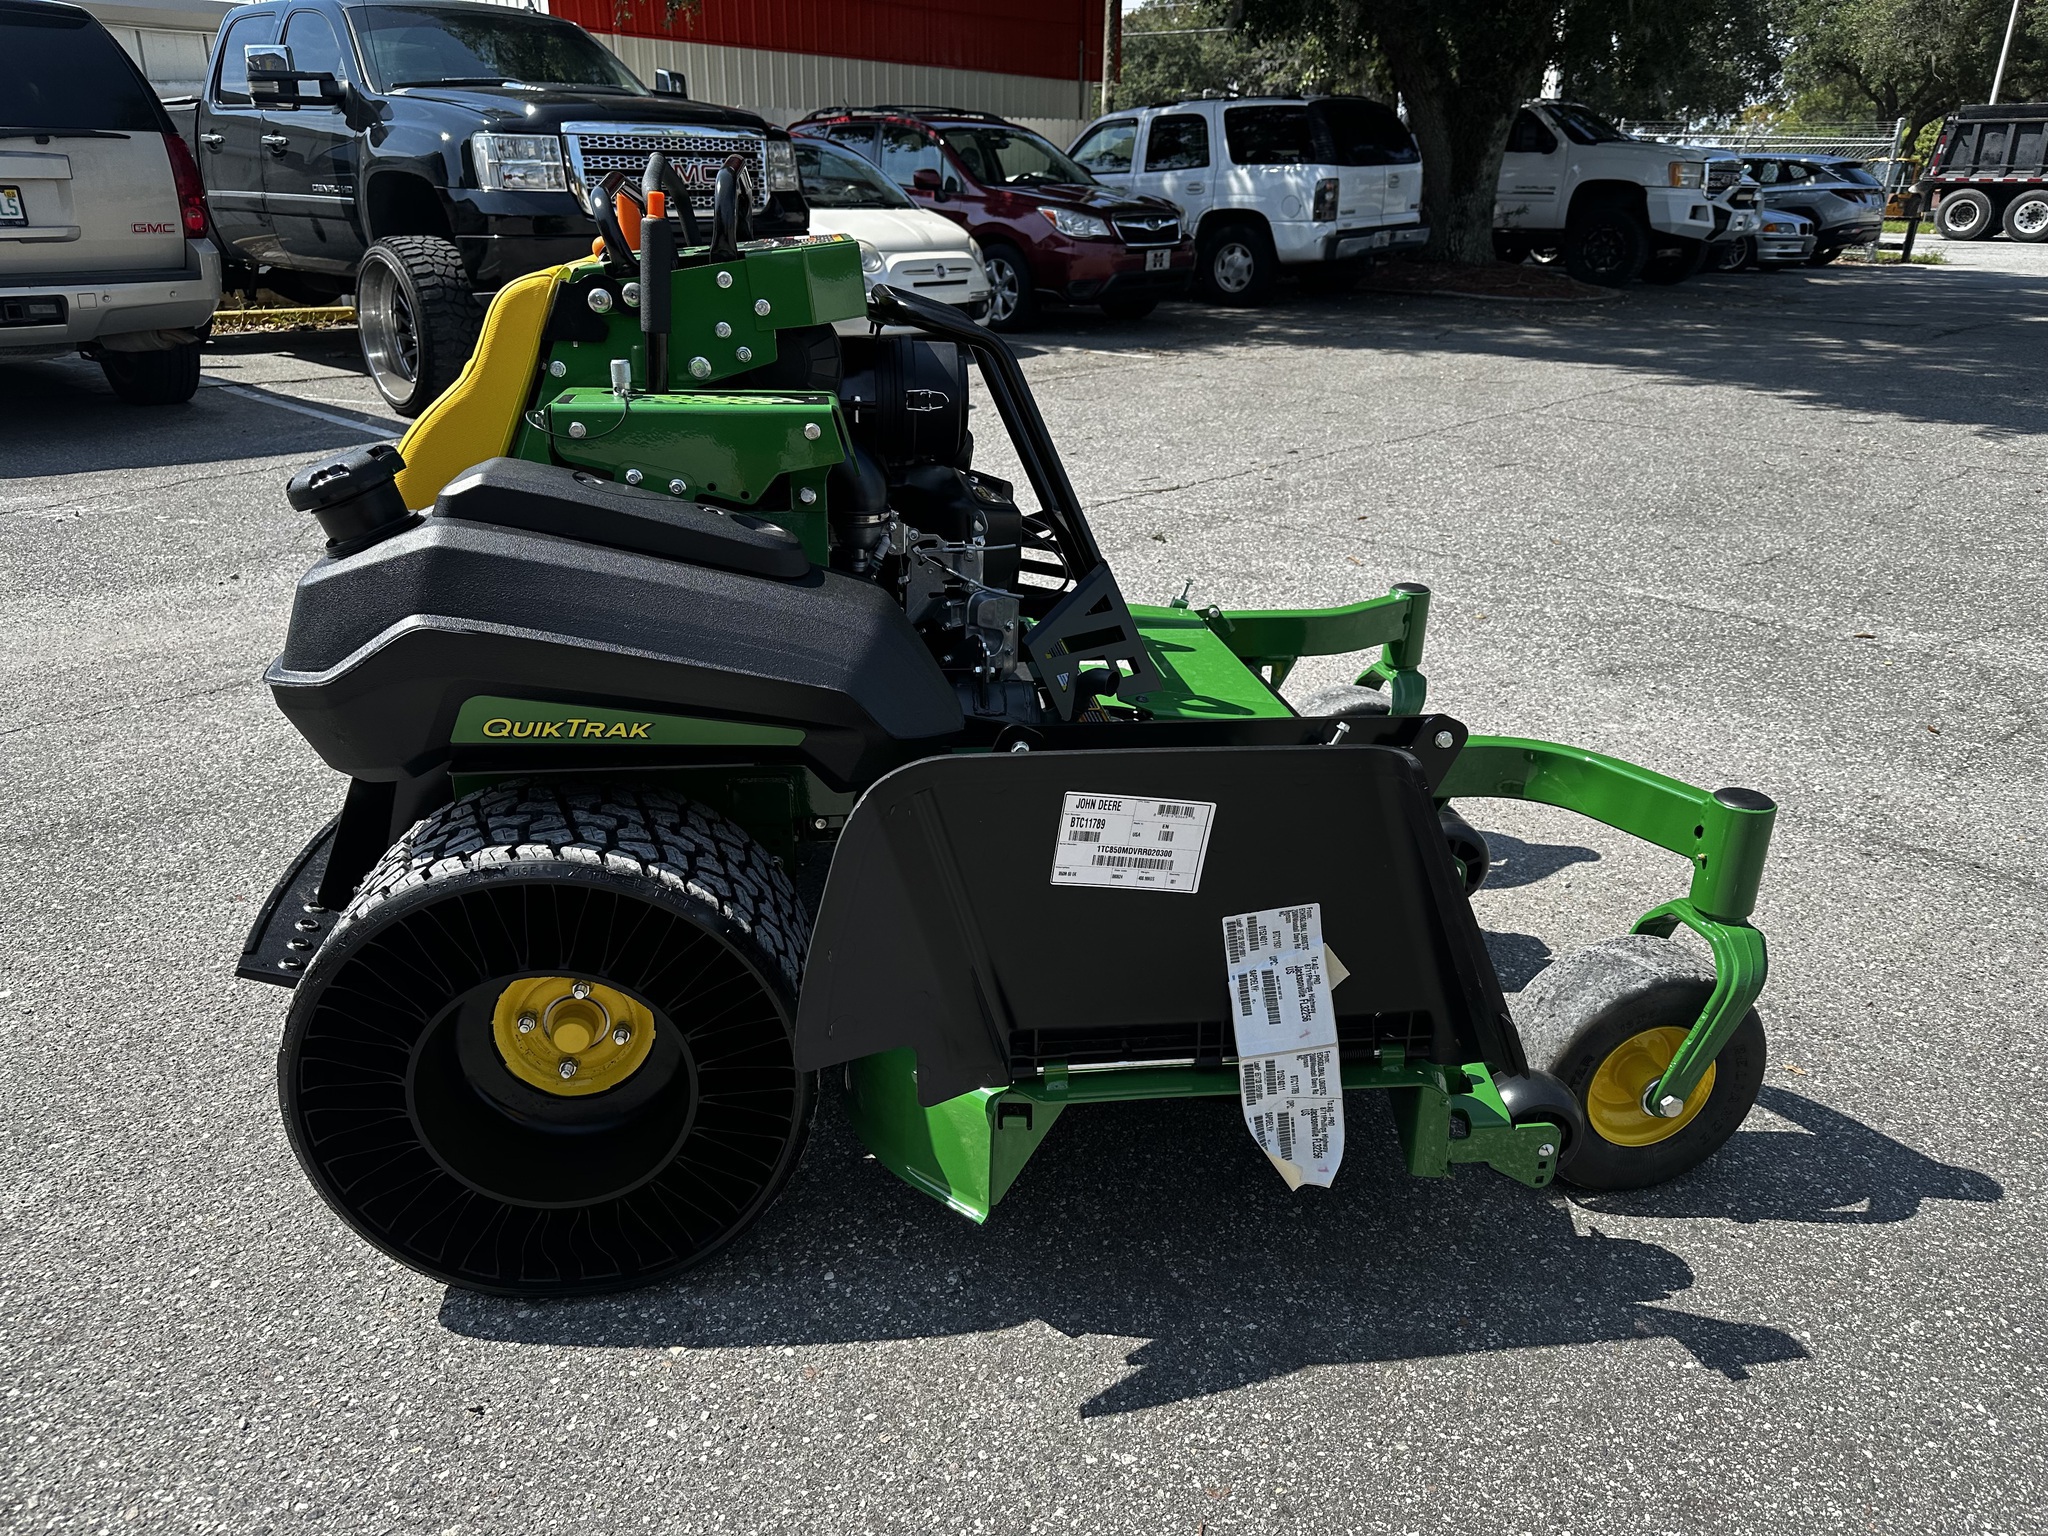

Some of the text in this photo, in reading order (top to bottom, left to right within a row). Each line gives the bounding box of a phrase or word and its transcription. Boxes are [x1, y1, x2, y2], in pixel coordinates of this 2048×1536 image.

[132, 222, 176, 233] GMC
[1075, 798, 1123, 812] JOHN DEERE
[1070, 817, 1106, 830] BTC11789
[1097, 845, 1173, 858] 1TC850MDVRR020300
[1285, 966, 1295, 975] US
[1294, 965, 1312, 1022] Jacksonville FL32256
[1300, 1108, 1310, 1116] US
[1310, 1108, 1323, 1159] Jacksonville FL32256
